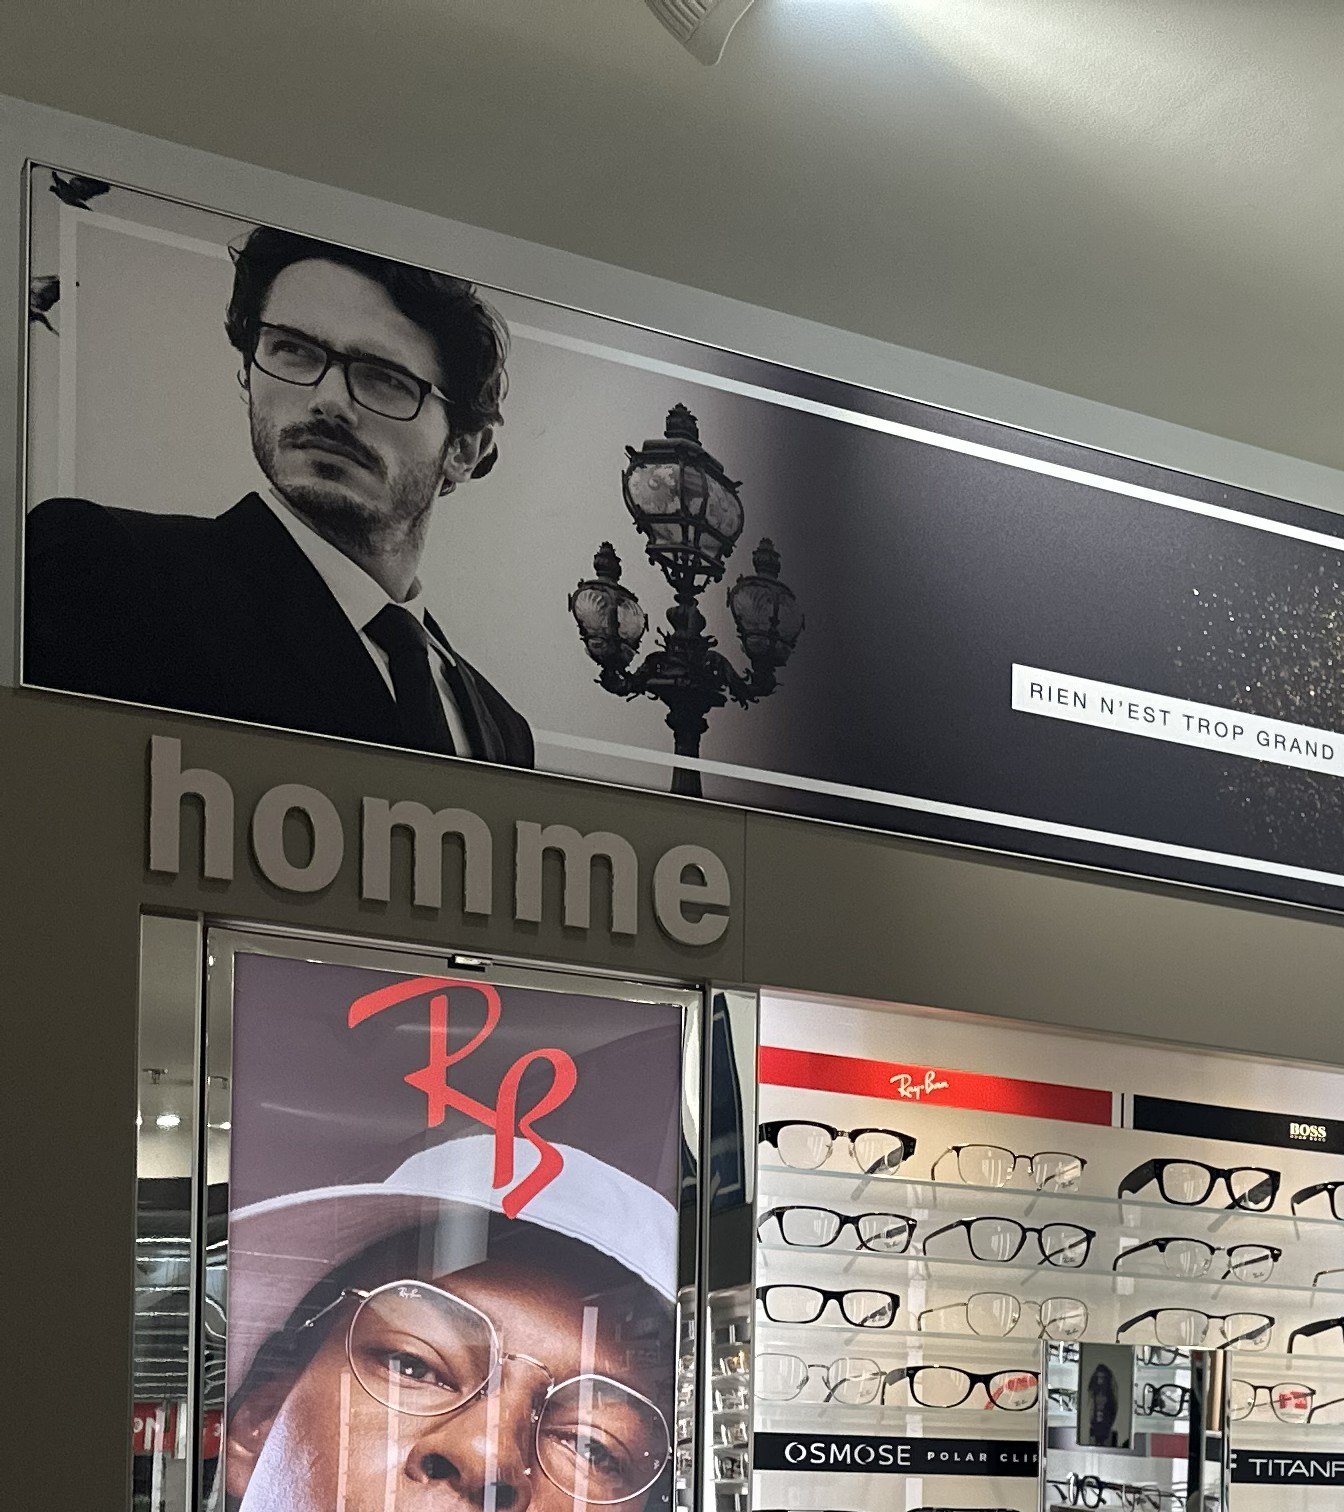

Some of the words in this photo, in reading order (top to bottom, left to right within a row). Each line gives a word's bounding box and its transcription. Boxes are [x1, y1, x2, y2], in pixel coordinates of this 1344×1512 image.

[1030, 682, 1088, 709] RIEN
[1100, 696, 1173, 727] N'EST
[1181, 713, 1246, 740] TROP
[1255, 730, 1335, 761] GRAND
[148, 734, 731, 946] homme
[889, 1070, 950, 1100] Ray-Ban
[1289, 1123, 1327, 1138] BOSS
[784, 1440, 912, 1467] OSMOSE
[926, 1451, 988, 1463] POLAR
